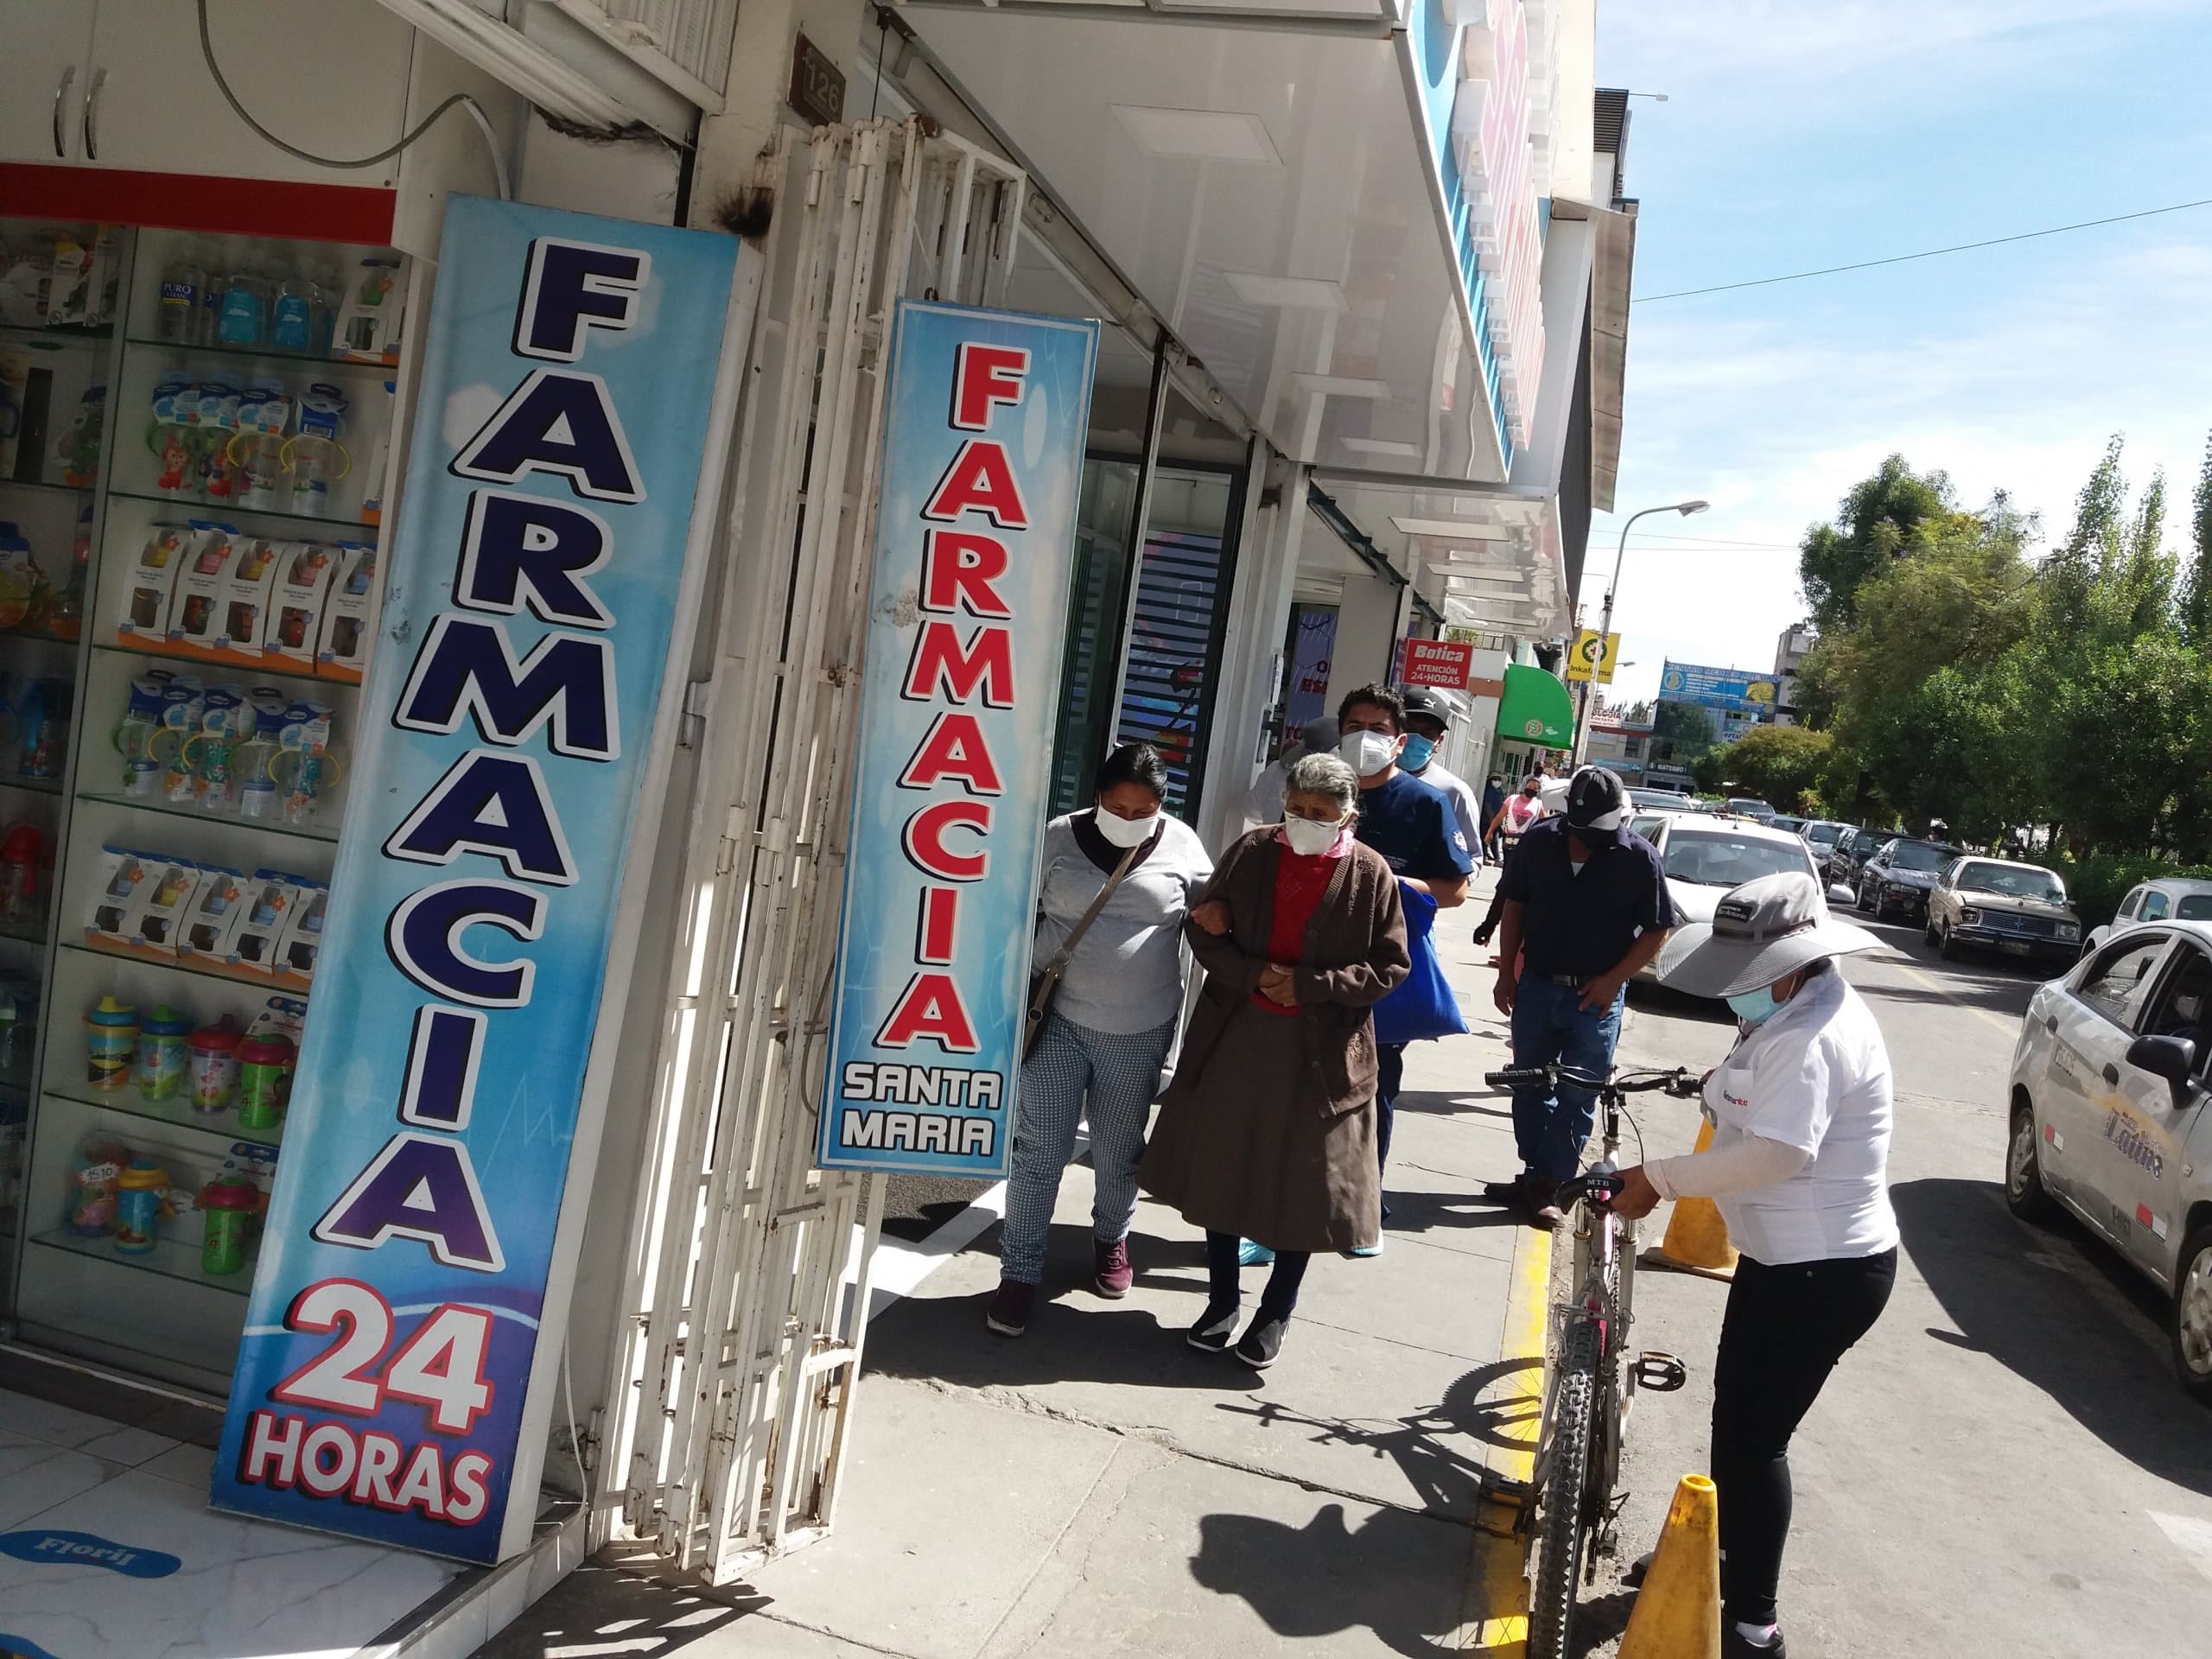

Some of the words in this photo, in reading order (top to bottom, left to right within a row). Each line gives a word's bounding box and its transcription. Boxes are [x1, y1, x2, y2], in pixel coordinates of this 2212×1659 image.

[1414, 645, 1465, 663] Botica
[1415, 664, 1459, 676] ATENCIÓN
[1570, 664, 1612, 677] Inkafma
[872, 340, 1032, 1053] FARMACIA
[1427, 674, 1461, 685] HORAS
[310, 235, 652, 1273] FARMACIA
[842, 1062, 1004, 1110] SANTA
[840, 1109, 995, 1156] MARIA
[268, 1277, 494, 1436] 24
[238, 1410, 493, 1527] HORAS
